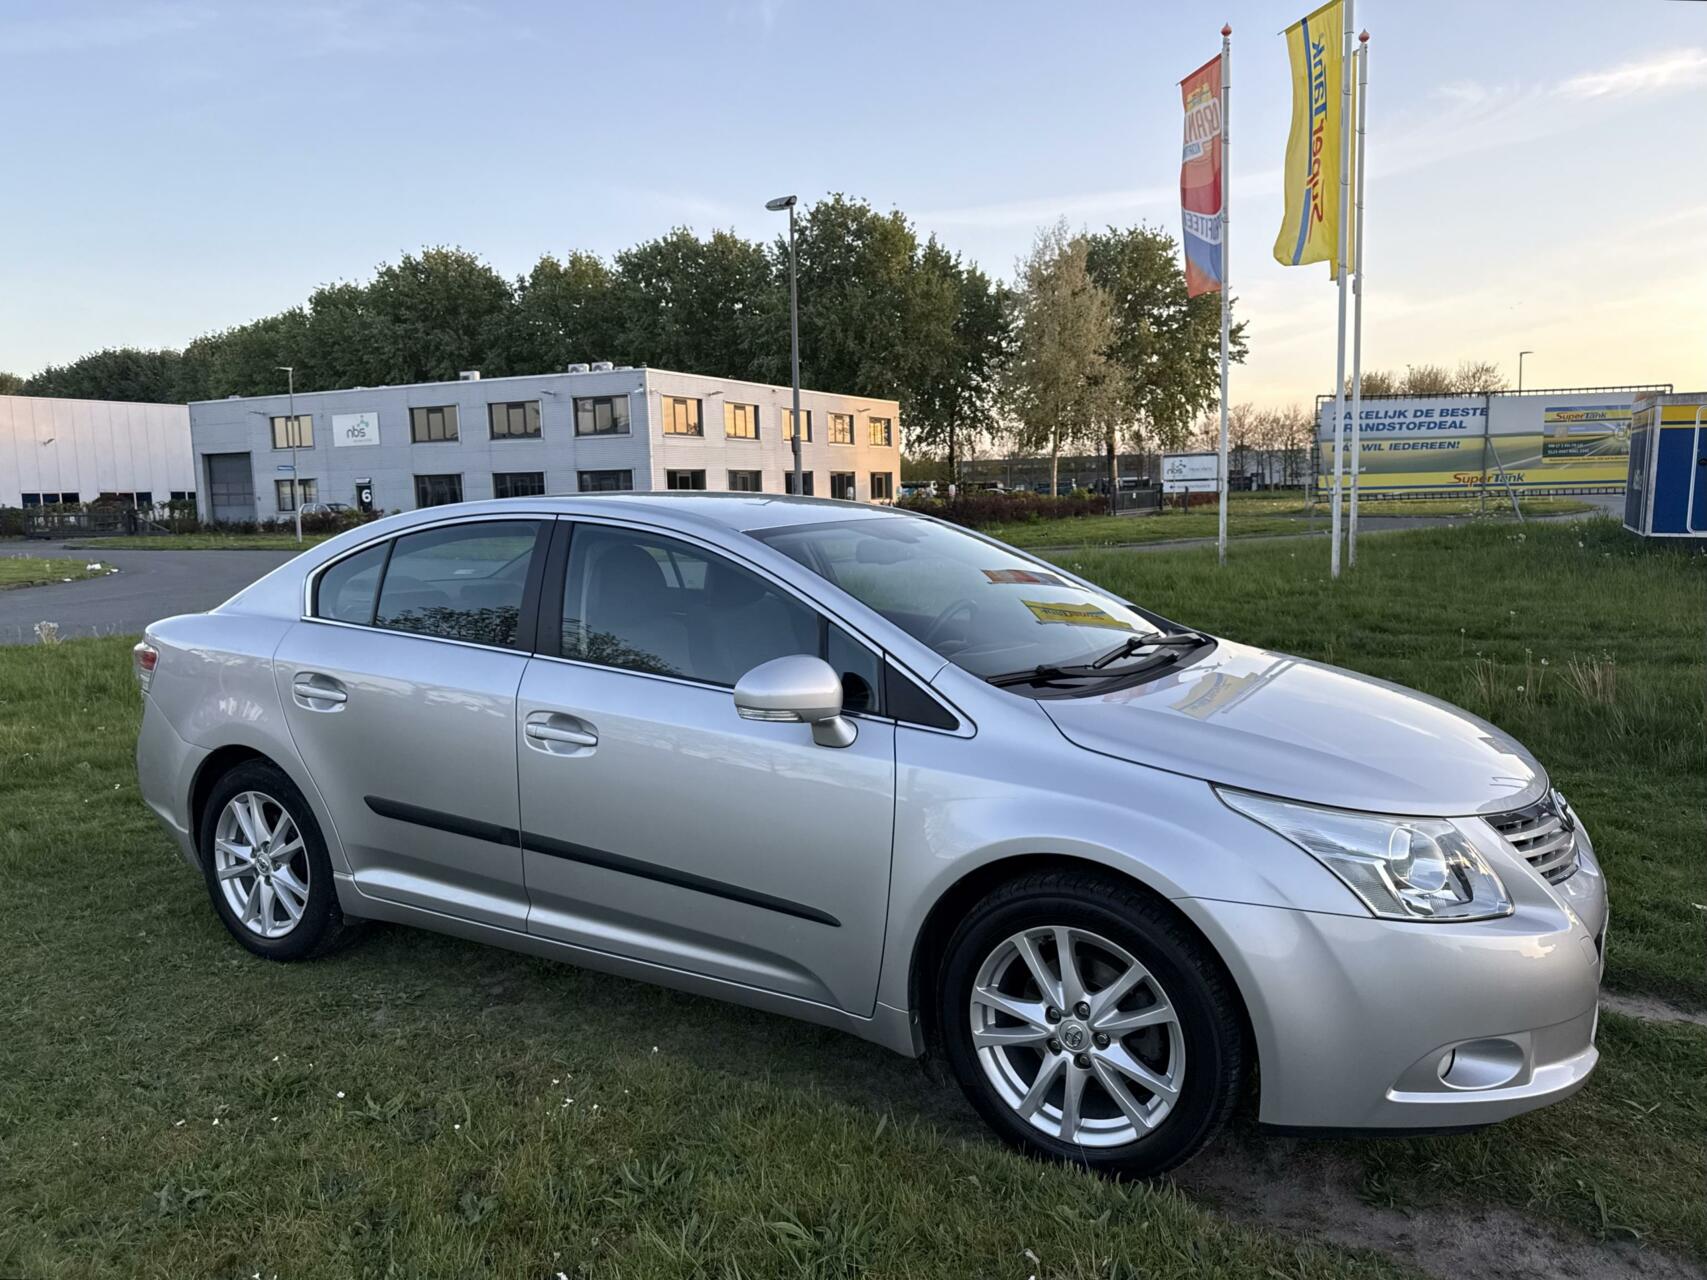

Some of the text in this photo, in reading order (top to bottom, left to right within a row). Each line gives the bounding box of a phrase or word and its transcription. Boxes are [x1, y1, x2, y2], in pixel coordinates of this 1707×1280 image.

[1412, 408, 1435, 418] DE
[1439, 407, 1489, 418] BESTE
[346, 425, 366, 438] nbs
[1361, 443, 1384, 452] WIL
[1388, 441, 1461, 451] IEDEREEN!
[361, 489, 371, 502] 6
